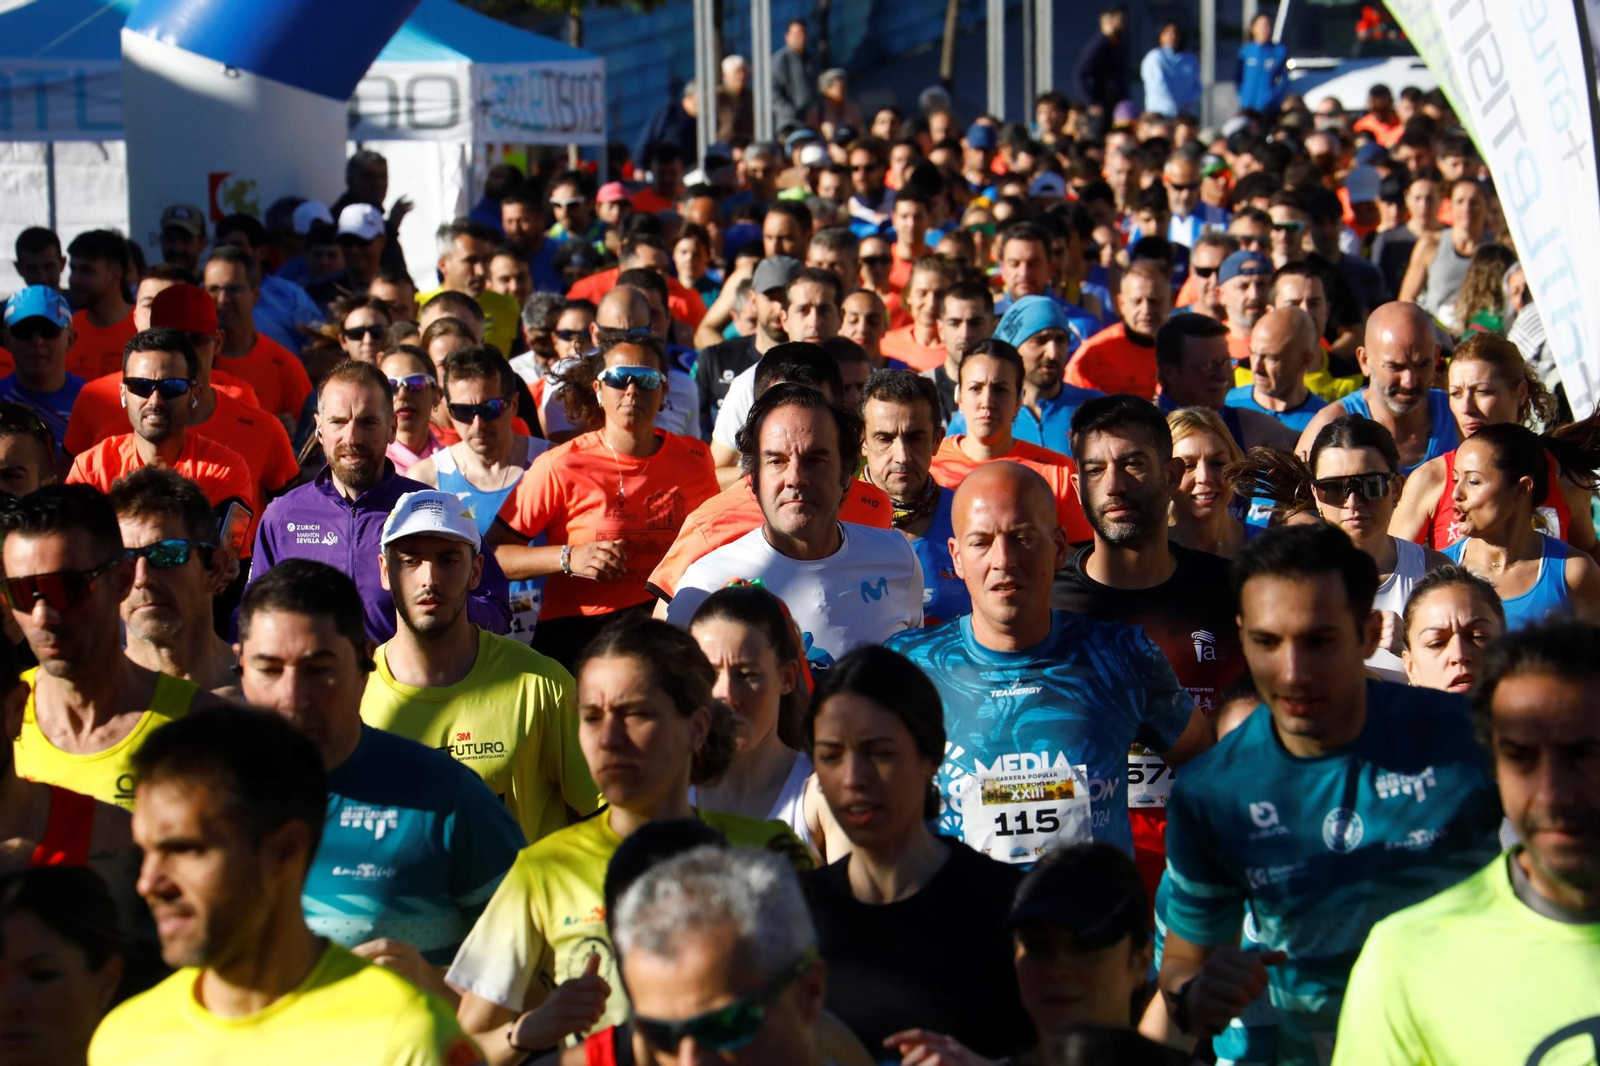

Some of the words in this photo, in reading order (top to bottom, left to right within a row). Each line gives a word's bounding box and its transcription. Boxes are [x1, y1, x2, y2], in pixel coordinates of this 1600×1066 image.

[990, 686, 1043, 698] TEAMERGY
[456, 731, 472, 742] 3M
[447, 741, 505, 757] FUTURO
[974, 750, 1071, 775] MEDIA
[996, 773, 1026, 782] CARRERA
[1027, 771, 1058, 780] POPULAR
[1000, 782, 1025, 790] PUENTE
[1087, 770, 1119, 803] ÓN
[1011, 787, 1045, 801] XXIII
[994, 808, 1060, 837] 115
[1090, 809, 1110, 828] 024
